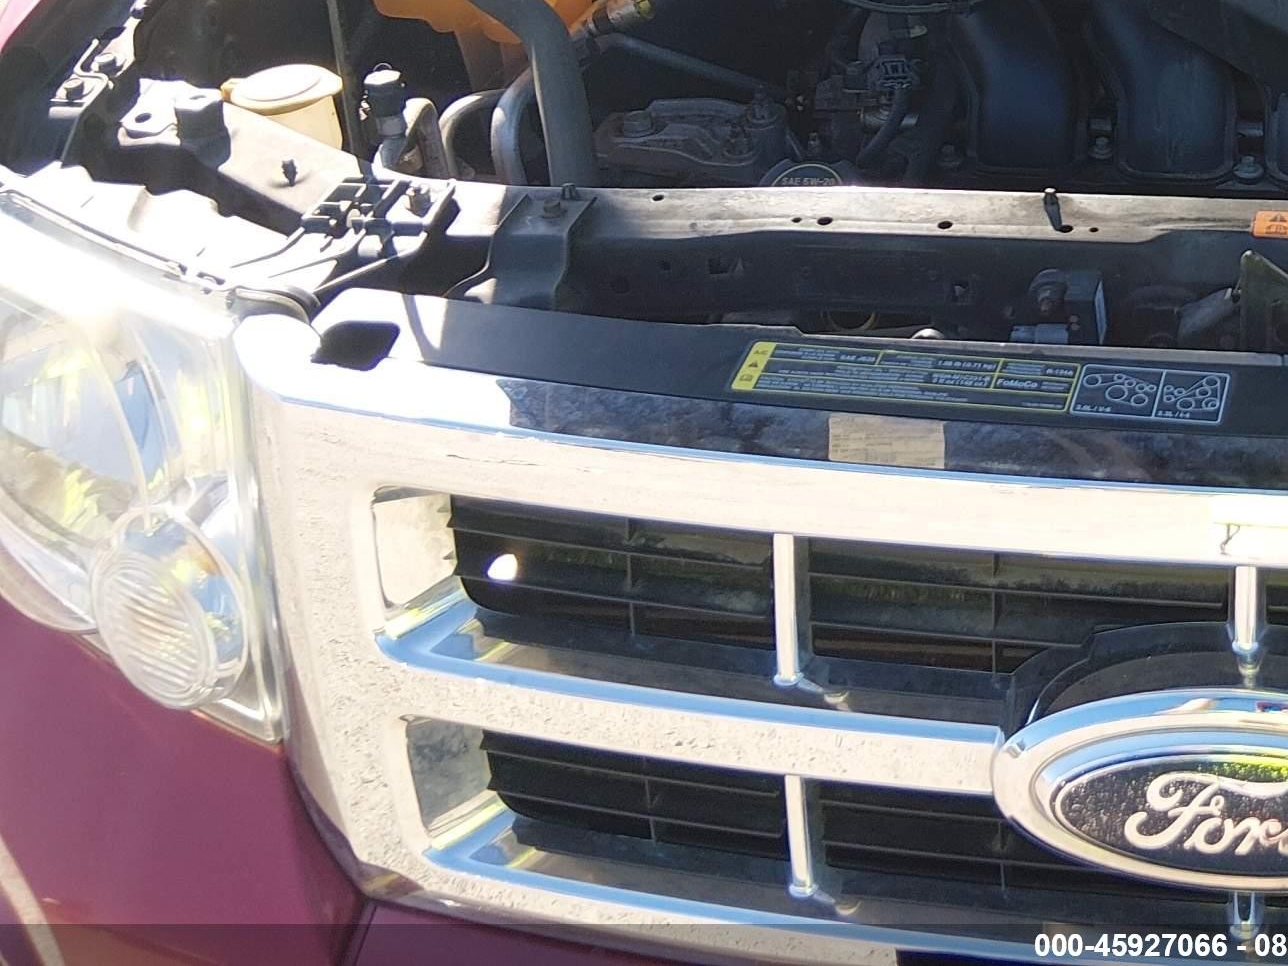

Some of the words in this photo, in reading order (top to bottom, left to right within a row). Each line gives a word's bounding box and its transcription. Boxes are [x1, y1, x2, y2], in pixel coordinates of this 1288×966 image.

[781, 177, 801, 186] SAE
[802, 177, 836, 186] 5W-20
[996, 378, 1039, 389] FoMoCo
